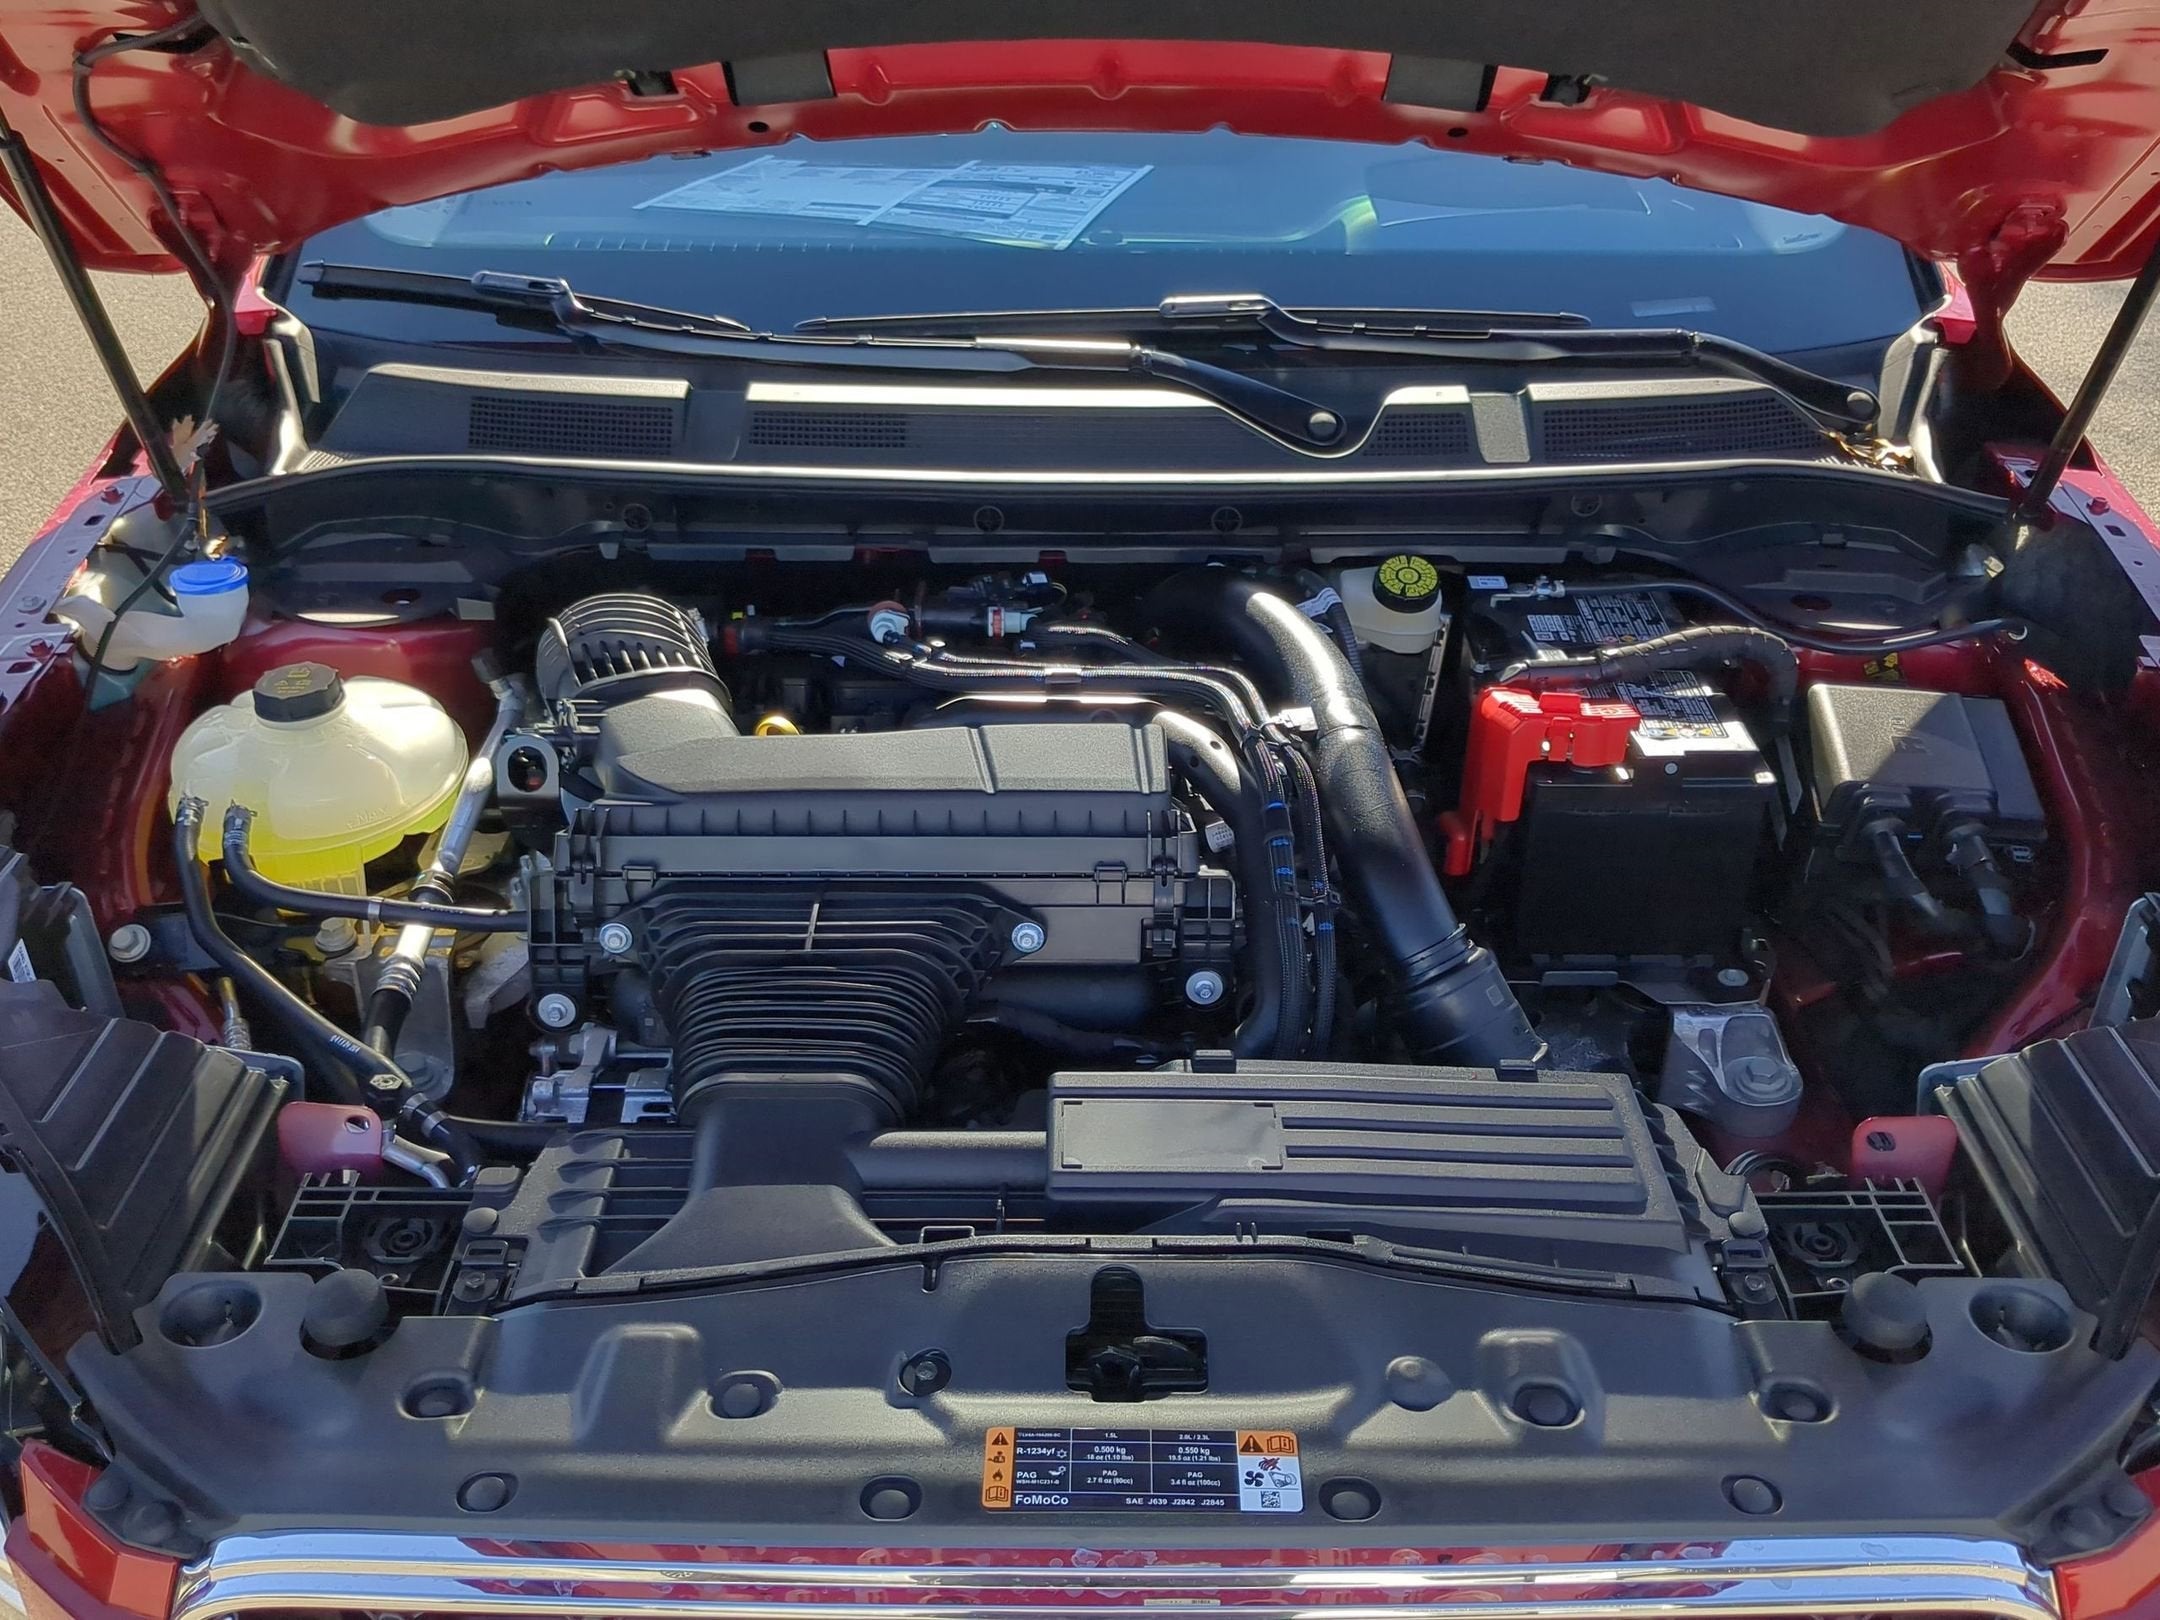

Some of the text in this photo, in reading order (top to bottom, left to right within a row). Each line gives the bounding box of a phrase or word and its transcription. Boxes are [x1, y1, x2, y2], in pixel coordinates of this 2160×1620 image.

[1016, 1447, 1055, 1456] R-1234yf
[1116, 1446, 1126, 1454] kg
[1200, 1447, 1210, 1455] kg
[1016, 1471, 1037, 1479] PAG
[1015, 1494, 1069, 1505] FoMoCo
[1125, 1497, 1144, 1505] SAE
[1171, 1498, 1196, 1506] J2842
